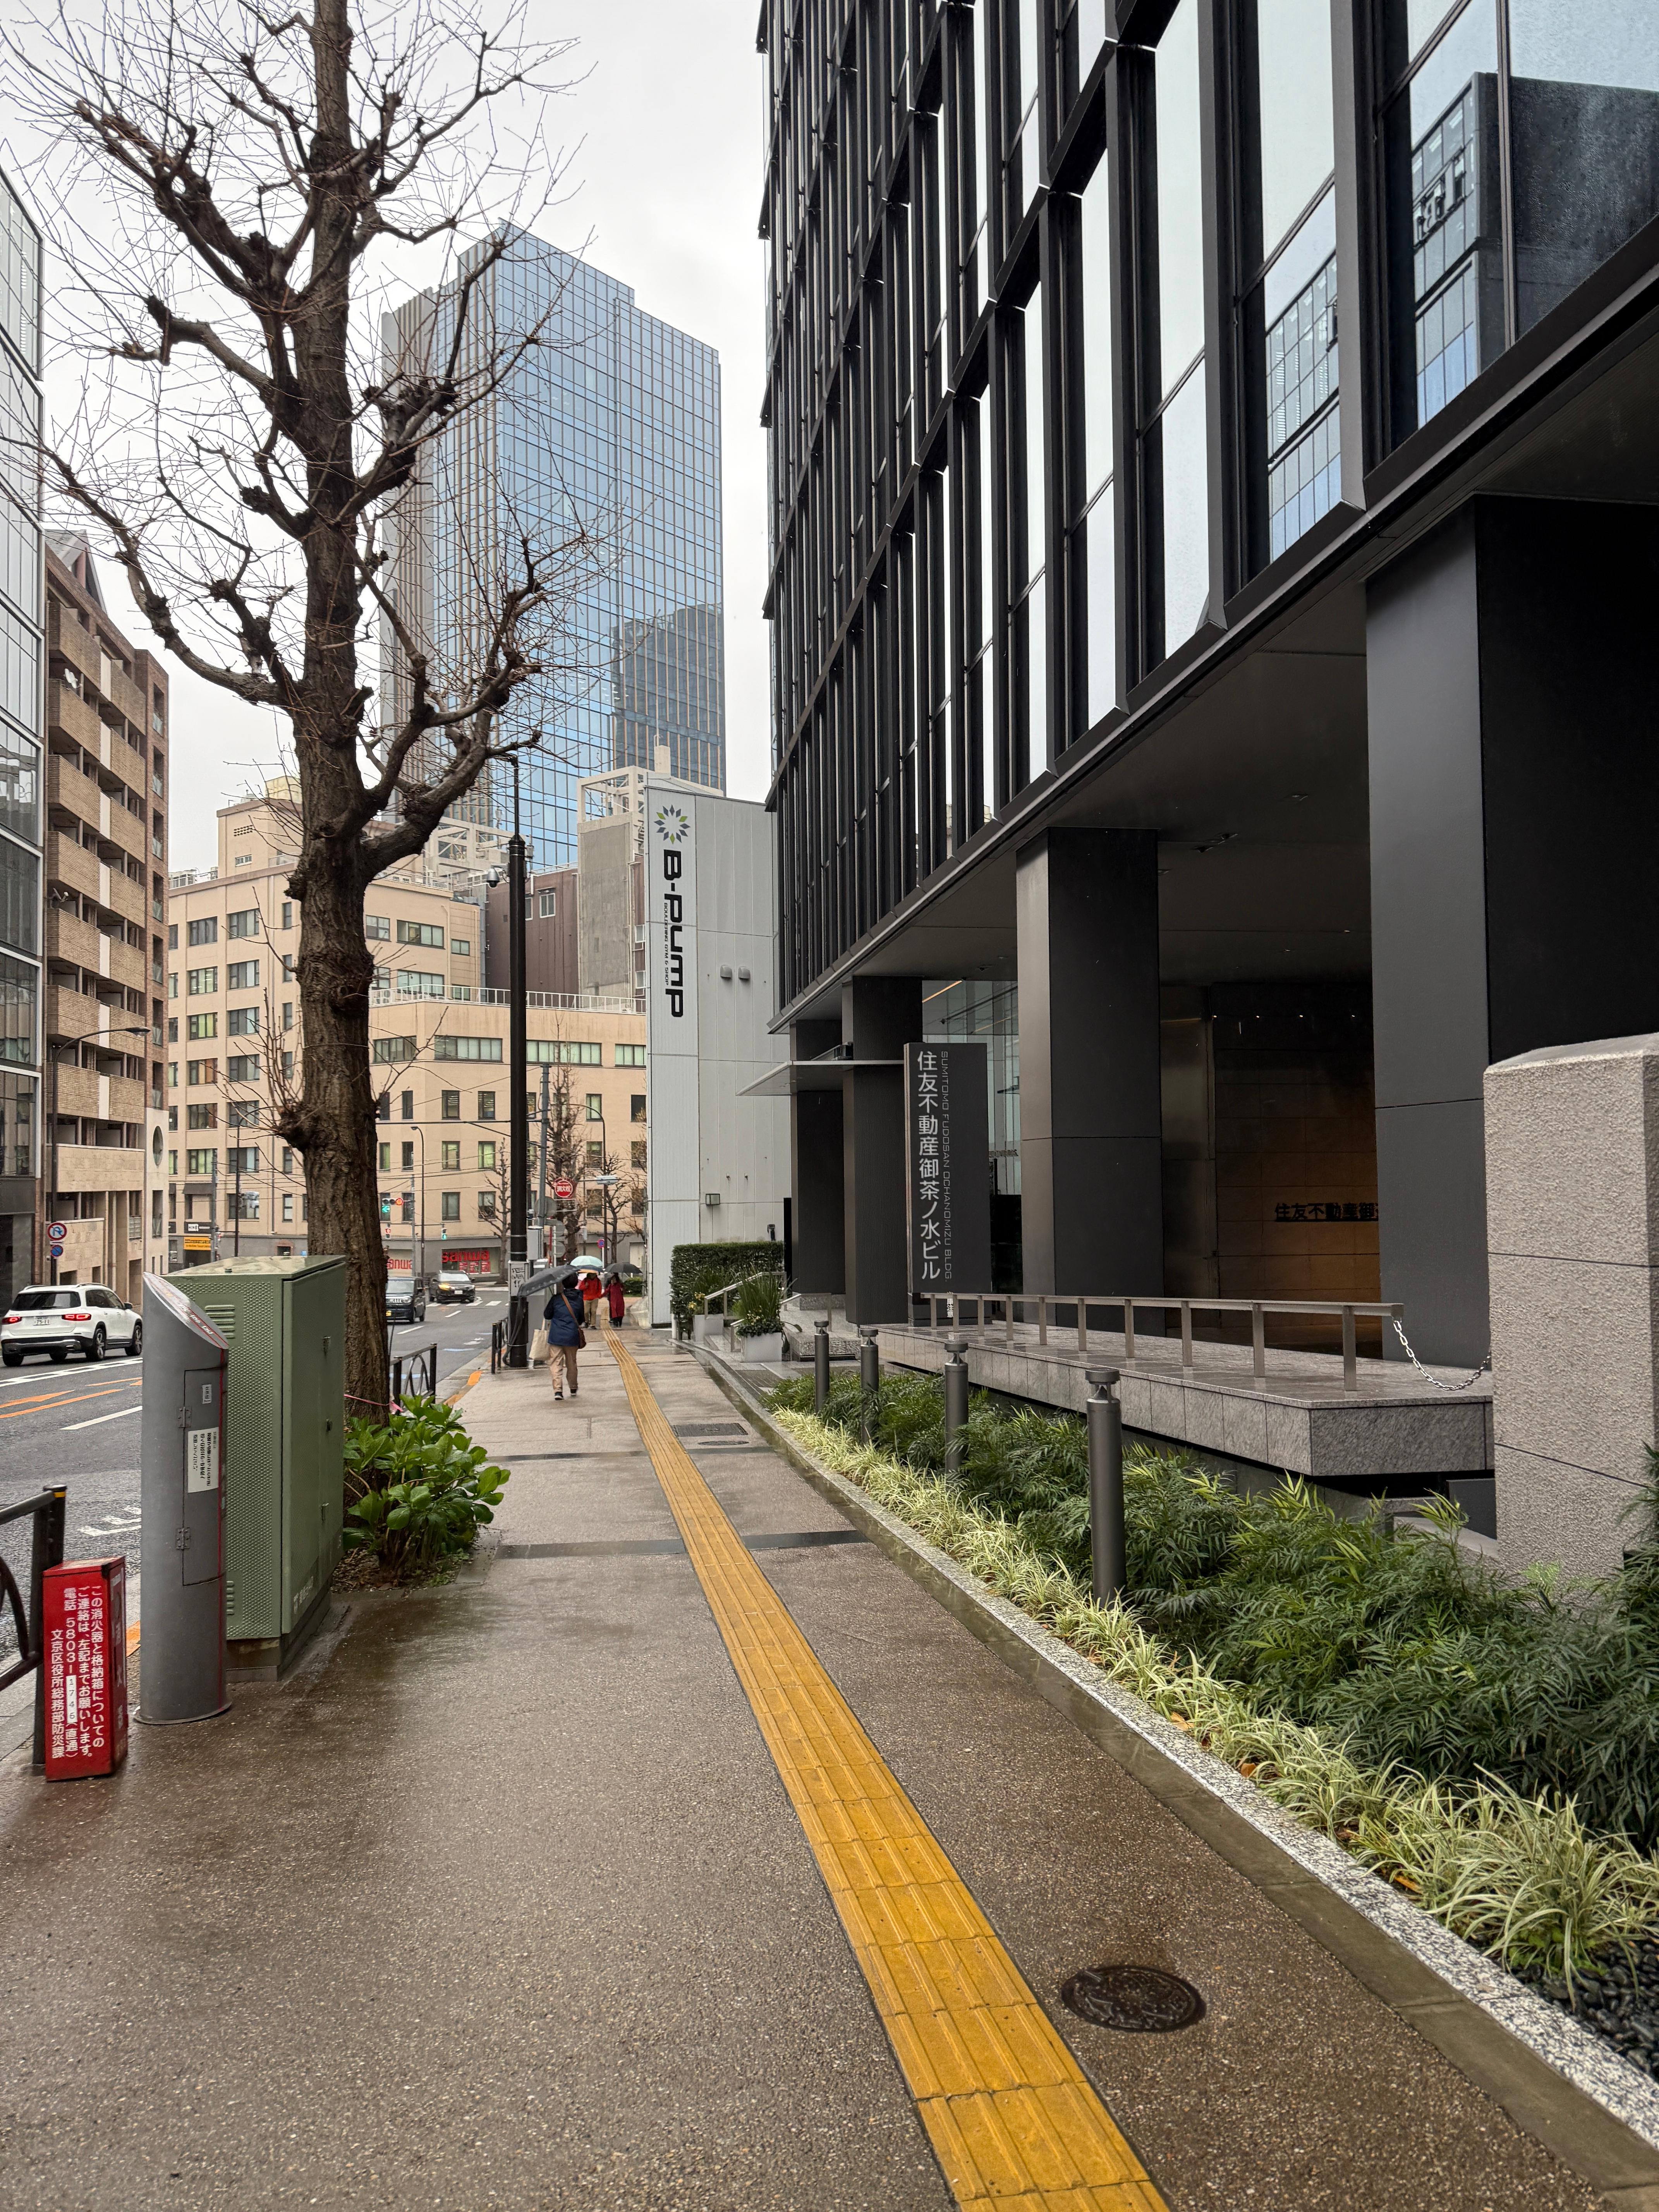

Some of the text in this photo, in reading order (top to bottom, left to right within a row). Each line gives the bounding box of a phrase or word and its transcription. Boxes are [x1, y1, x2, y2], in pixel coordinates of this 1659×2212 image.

[917, 1050, 941, 1280] 住友不動産御茶ノ水ビル
[943, 1171, 951, 1245] OCHANOMIZU
[386, 1258, 412, 1269] anwa
[441, 1250, 489, 1263] sanwa
